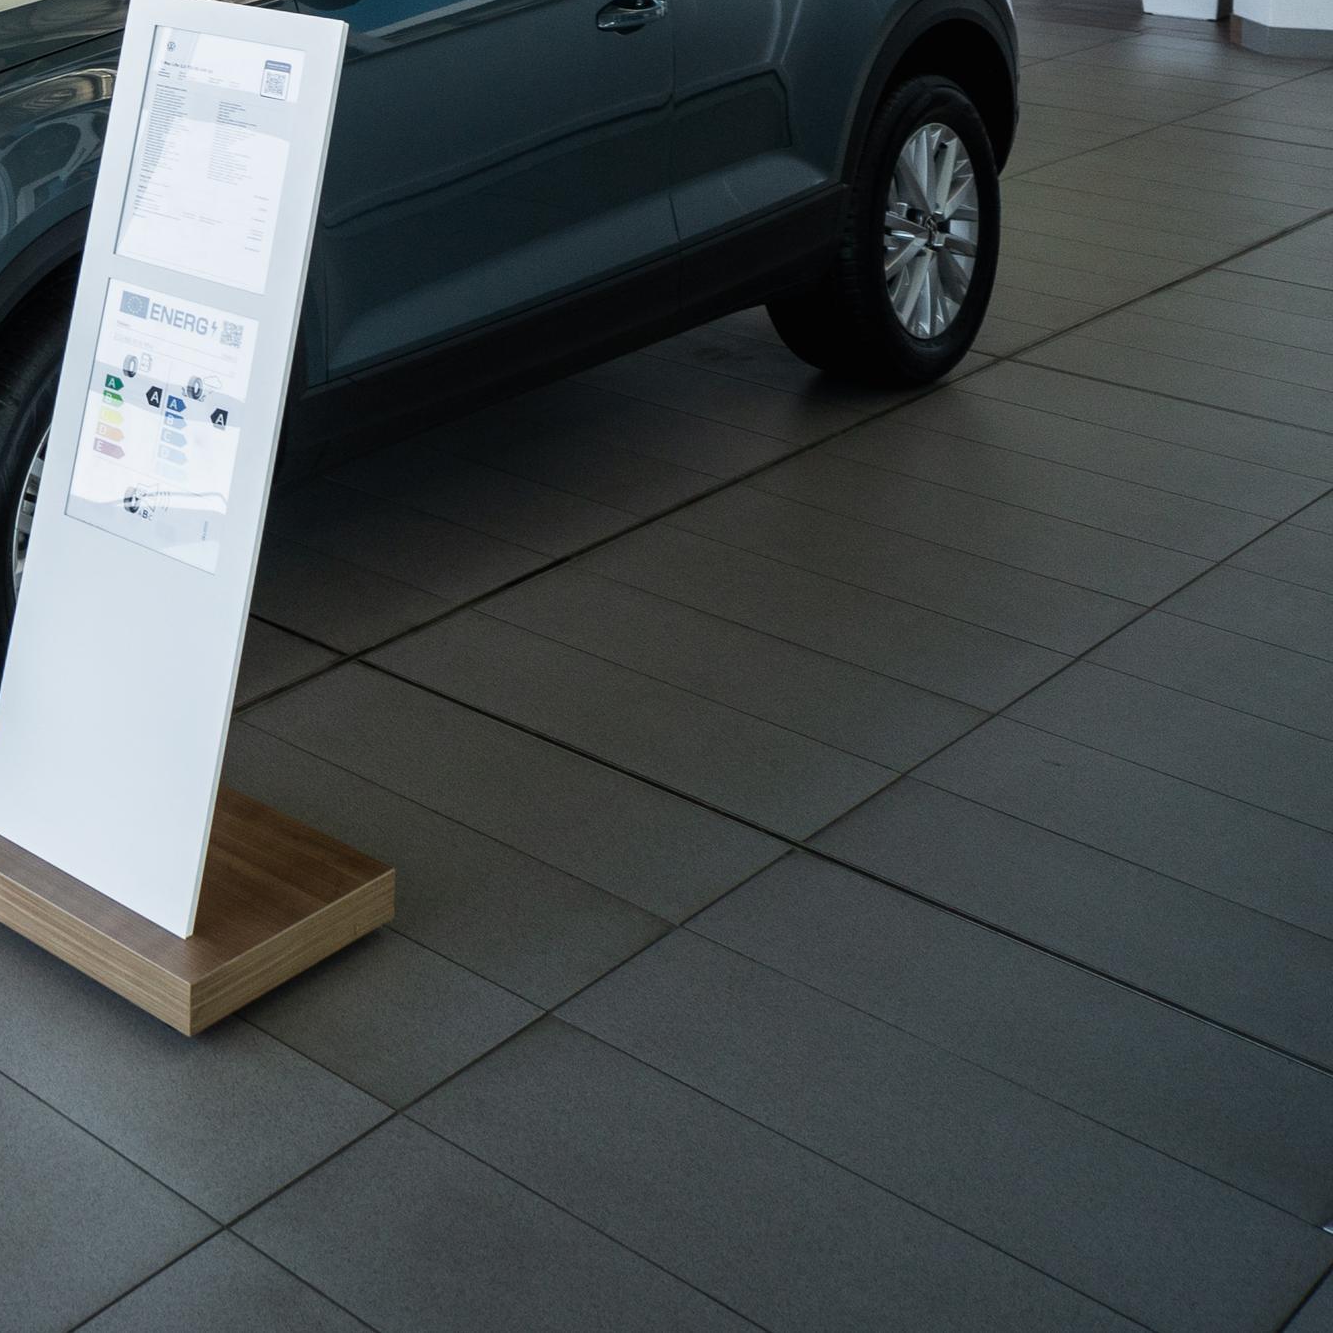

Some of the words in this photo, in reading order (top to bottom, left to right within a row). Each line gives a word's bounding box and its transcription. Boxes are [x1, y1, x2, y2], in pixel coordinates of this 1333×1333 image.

[150, 302, 209, 336] ENERG
[150, 392, 159, 404] A
[169, 399, 178, 410] A
[215, 414, 225, 426] A
